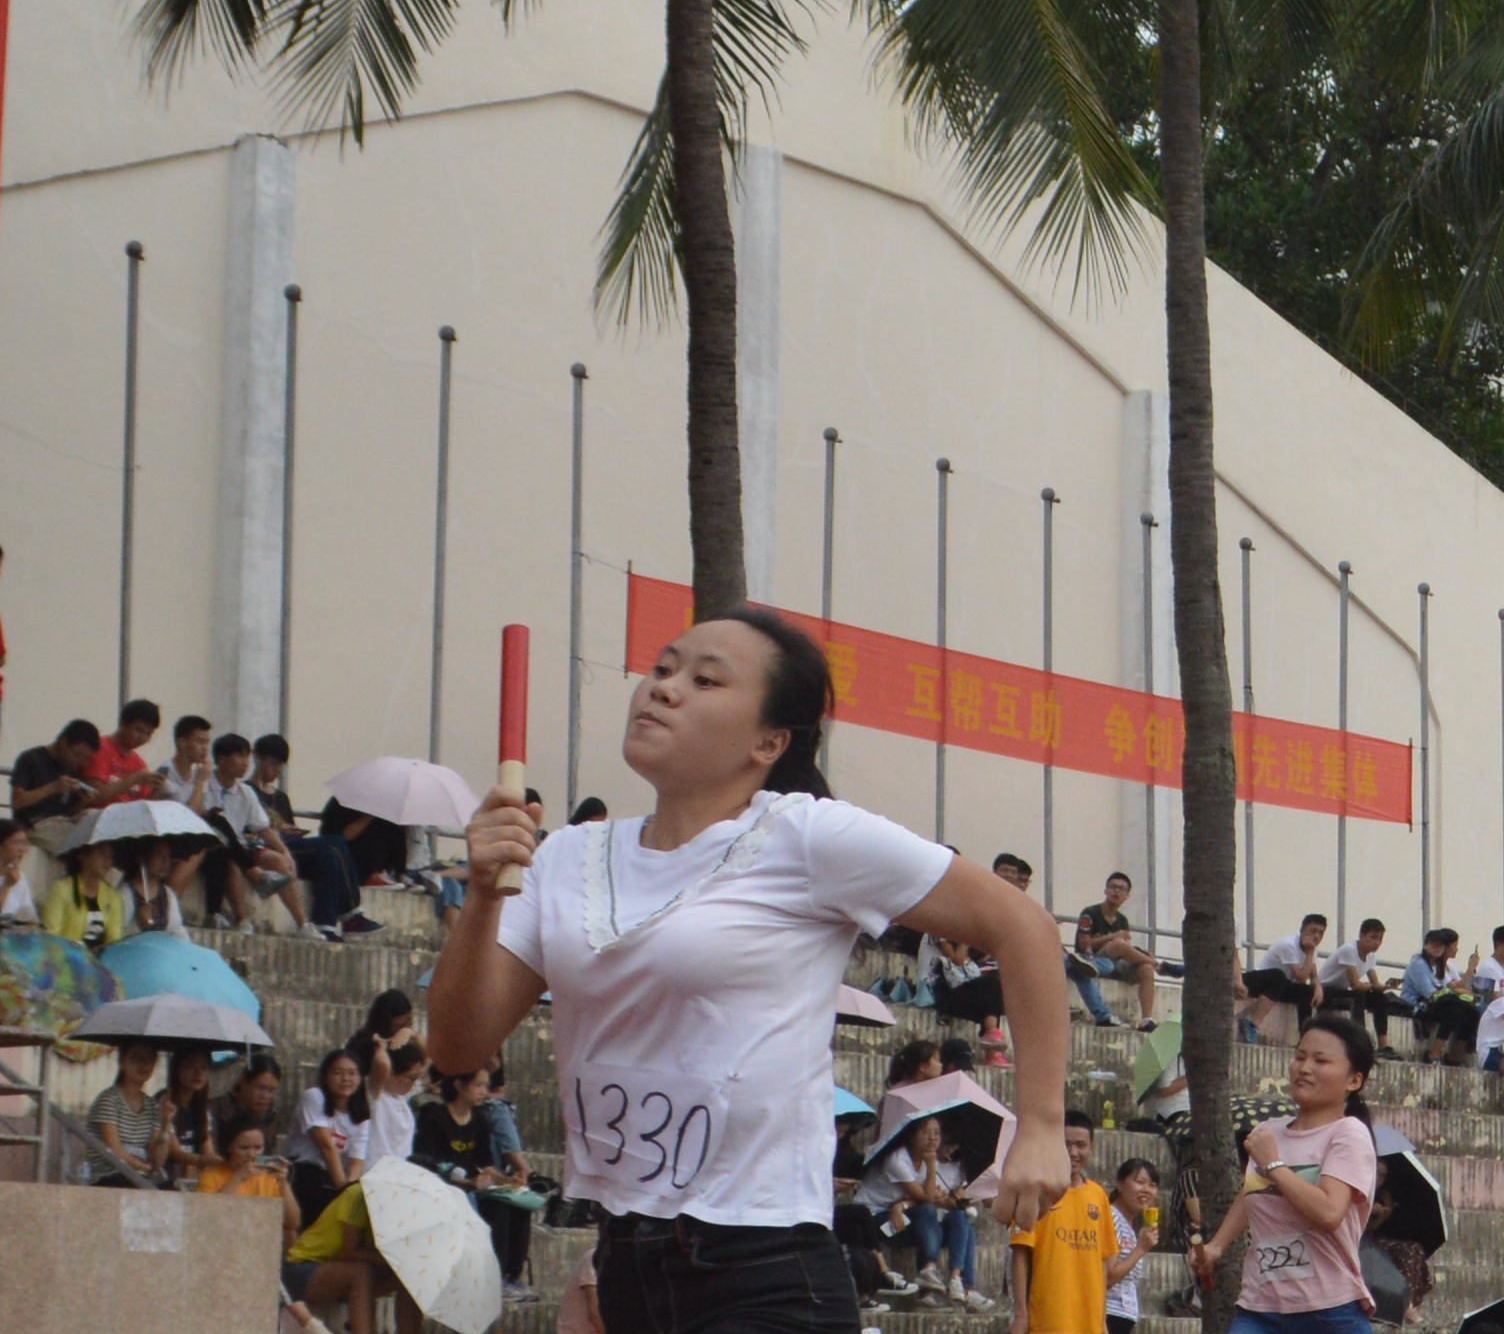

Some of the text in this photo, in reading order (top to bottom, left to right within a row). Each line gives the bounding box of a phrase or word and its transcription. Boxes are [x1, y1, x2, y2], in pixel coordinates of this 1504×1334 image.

[906, 662, 1379, 805] 互帮互助 争创先进集体
[575, 1077, 711, 1190] 1330
